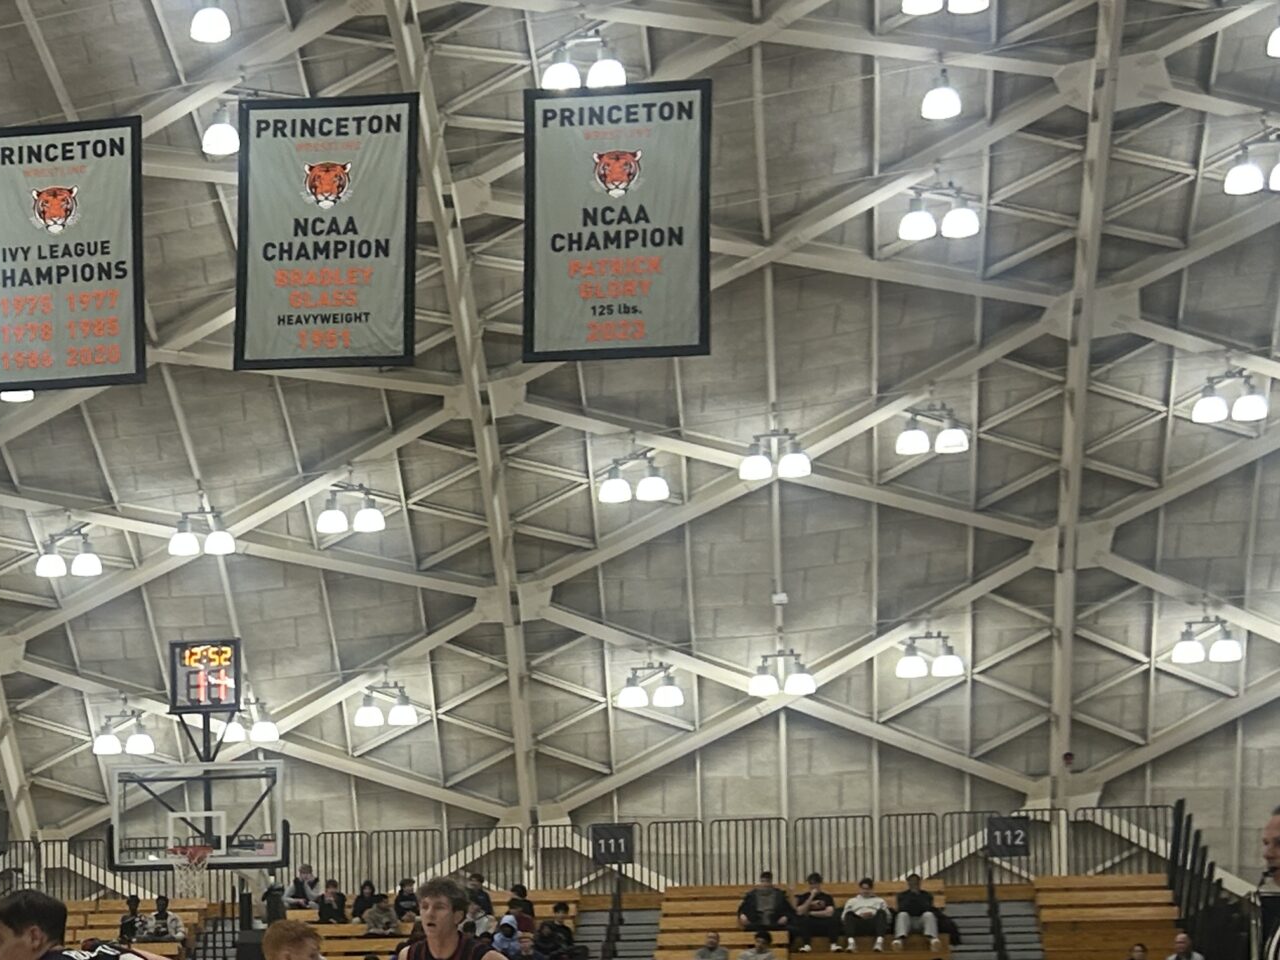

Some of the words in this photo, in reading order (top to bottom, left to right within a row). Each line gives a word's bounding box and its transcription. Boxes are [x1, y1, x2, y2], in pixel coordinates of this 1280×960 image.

[542, 100, 695, 128] PRINCETON
[256, 114, 402, 138] PRINCETON
[293, 216, 359, 237] NCAA
[582, 204, 650, 227] NCAA
[262, 239, 390, 261] CHAMPION
[550, 226, 684, 253] CHAMPION
[2, 246, 31, 262] IVY
[37, 240, 111, 260] LEAGUE
[274, 267, 374, 288] BRADLEY
[567, 255, 663, 279] PATRICK
[288, 289, 358, 309] GLASS
[591, 304, 614, 316] 125
[618, 303, 643, 315] lbs.
[277, 312, 371, 326] HEAVYWEIGHT
[65, 344, 121, 368] 2020
[598, 838, 625, 853] 111
[993, 829, 1025, 846] 112
